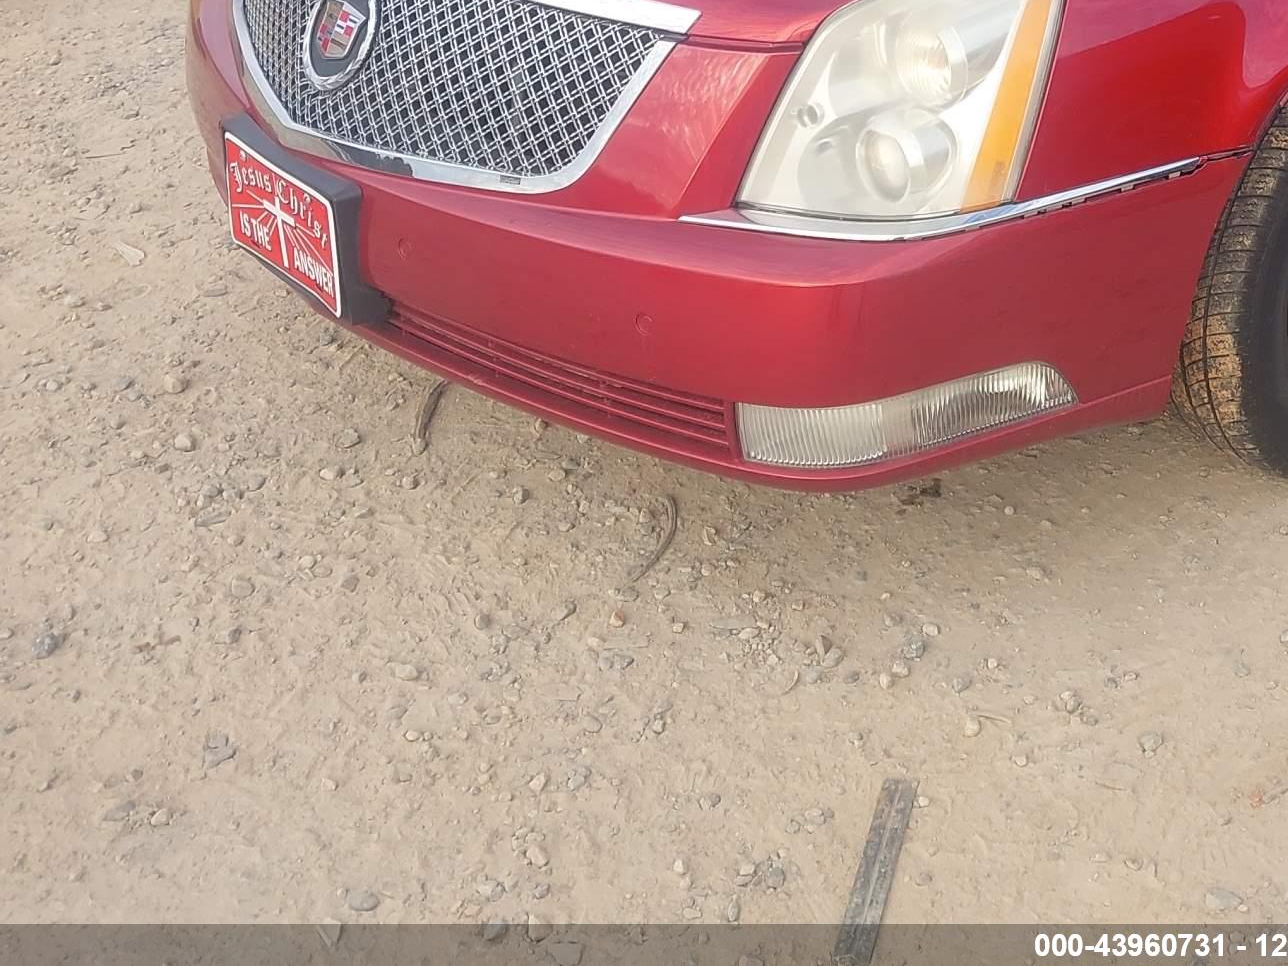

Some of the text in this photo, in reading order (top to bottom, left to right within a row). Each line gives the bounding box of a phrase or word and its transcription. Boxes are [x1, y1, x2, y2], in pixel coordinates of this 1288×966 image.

[229, 161, 328, 248] Jesus Christ
[240, 211, 335, 299] IS THE ANSWER
